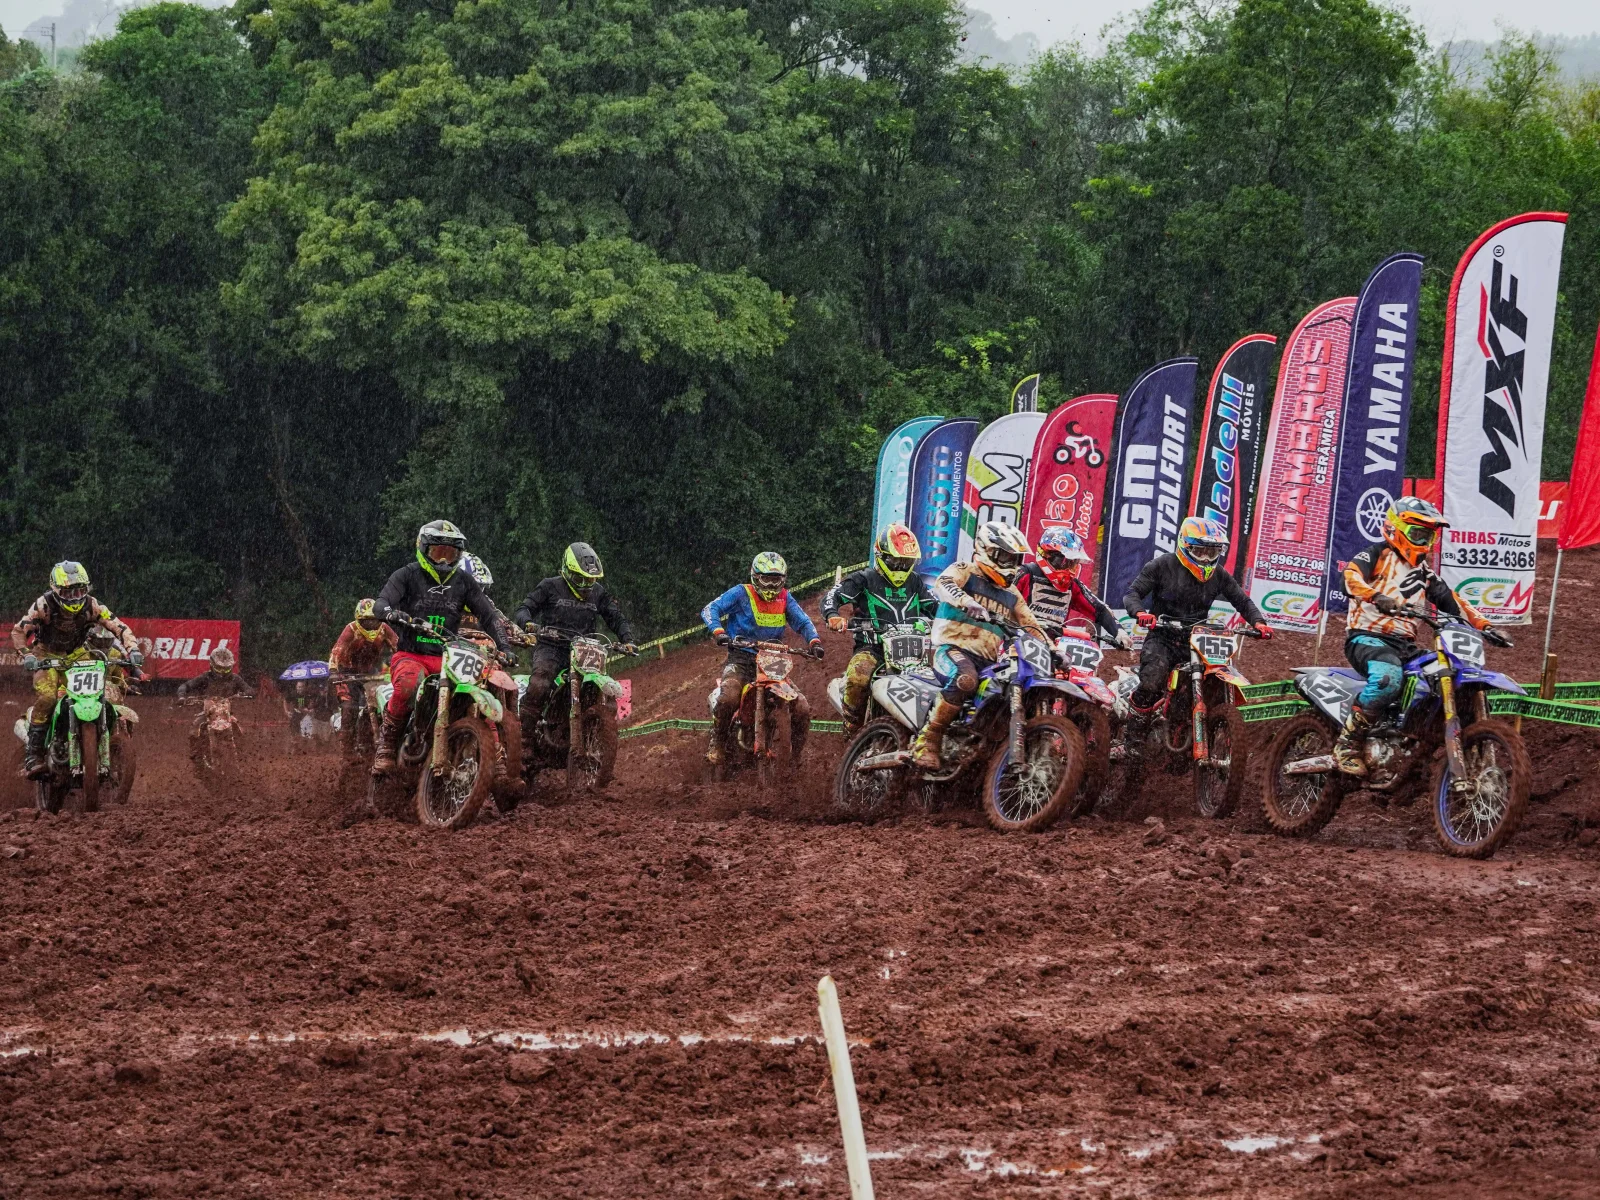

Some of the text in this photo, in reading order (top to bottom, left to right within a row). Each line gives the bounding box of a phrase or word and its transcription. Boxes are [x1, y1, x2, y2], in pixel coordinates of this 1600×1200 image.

[1364, 303, 1408, 475] YAMAHA
[1478, 258, 1528, 520] MXF
[1315, 409, 1337, 485] CERÂMICA
[893, 436, 915, 520] ASPO
[950, 451, 963, 518] EQUIPAMENTOS
[925, 445, 952, 560] VISOTO
[1040, 473, 1079, 530] lão
[1075, 490, 1094, 540] Motos
[1449, 530, 1531, 548] RIBAS Motos
[1457, 548, 1535, 568] 3332-6368
[1024, 642, 1050, 671] 25
[1066, 645, 1101, 670] 62
[1196, 636, 1234, 657] 155
[1452, 632, 1483, 660] 27
[451, 652, 484, 677] 789
[73, 672, 98, 692] 541
[886, 683, 916, 703] 25
[1308, 679, 1353, 705] 27
